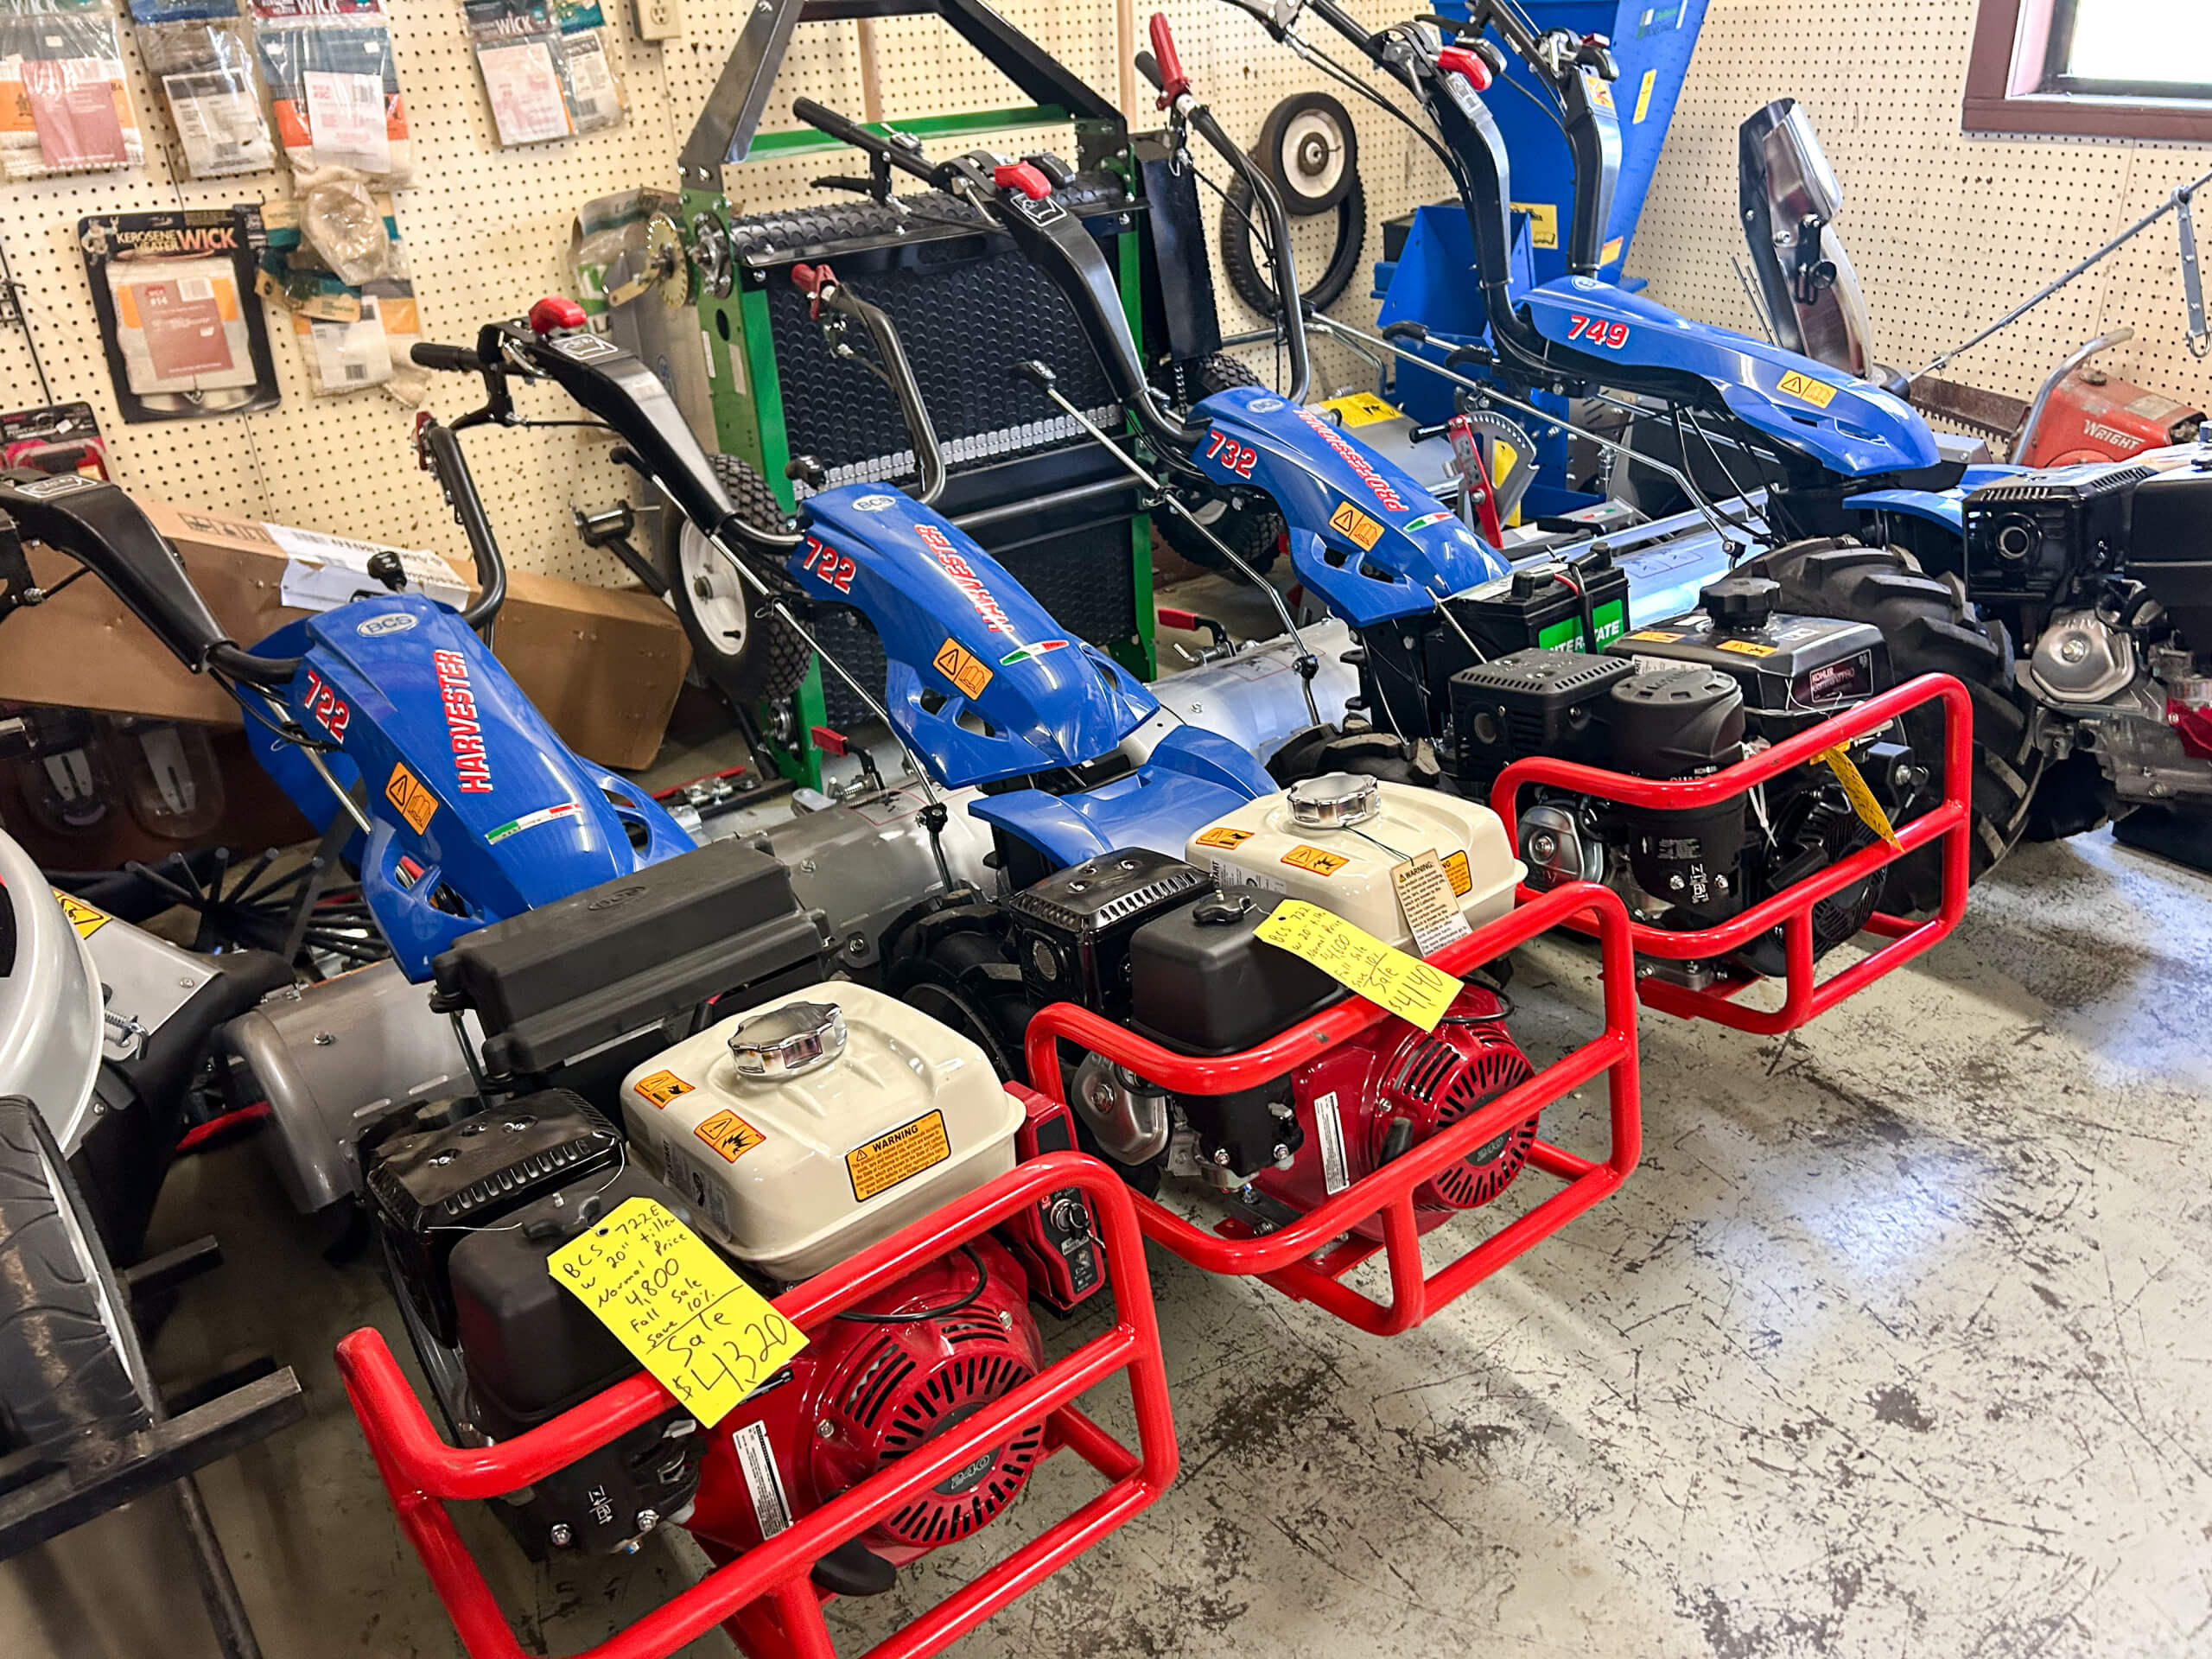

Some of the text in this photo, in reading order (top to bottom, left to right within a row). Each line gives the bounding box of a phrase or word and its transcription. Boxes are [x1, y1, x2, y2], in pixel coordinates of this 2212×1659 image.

[117, 228, 177, 245] KEROSENE
[177, 227, 238, 250] WICK
[1568, 314, 1630, 350] 749
[1206, 429, 1258, 480] 732
[2083, 418, 2146, 450] WRIGHT
[856, 495, 893, 511] BCS
[803, 536, 858, 595] 722
[914, 523, 1015, 632] HARVESTER
[365, 614, 413, 634] BCS
[304, 668, 350, 745] 722
[434, 649, 494, 793] HARVESTER
[1268, 906, 1312, 944] BCS 722
[1306, 918, 1344, 961] Normal Price
[1333, 945, 1369, 981] Fall Sale
[1369, 966, 1400, 995] Sale
[872, 1125, 918, 1152] WARNING
[563, 1204, 660, 1280] BCS 722E
[598, 1233, 689, 1308] Normal Price
[625, 1257, 679, 1306] 4,800
[630, 1277, 703, 1334] Fall Sale
[646, 1289, 716, 1349] Save 10%
[666, 1312, 733, 1368] Sale
[950, 1453, 990, 1490] 240
